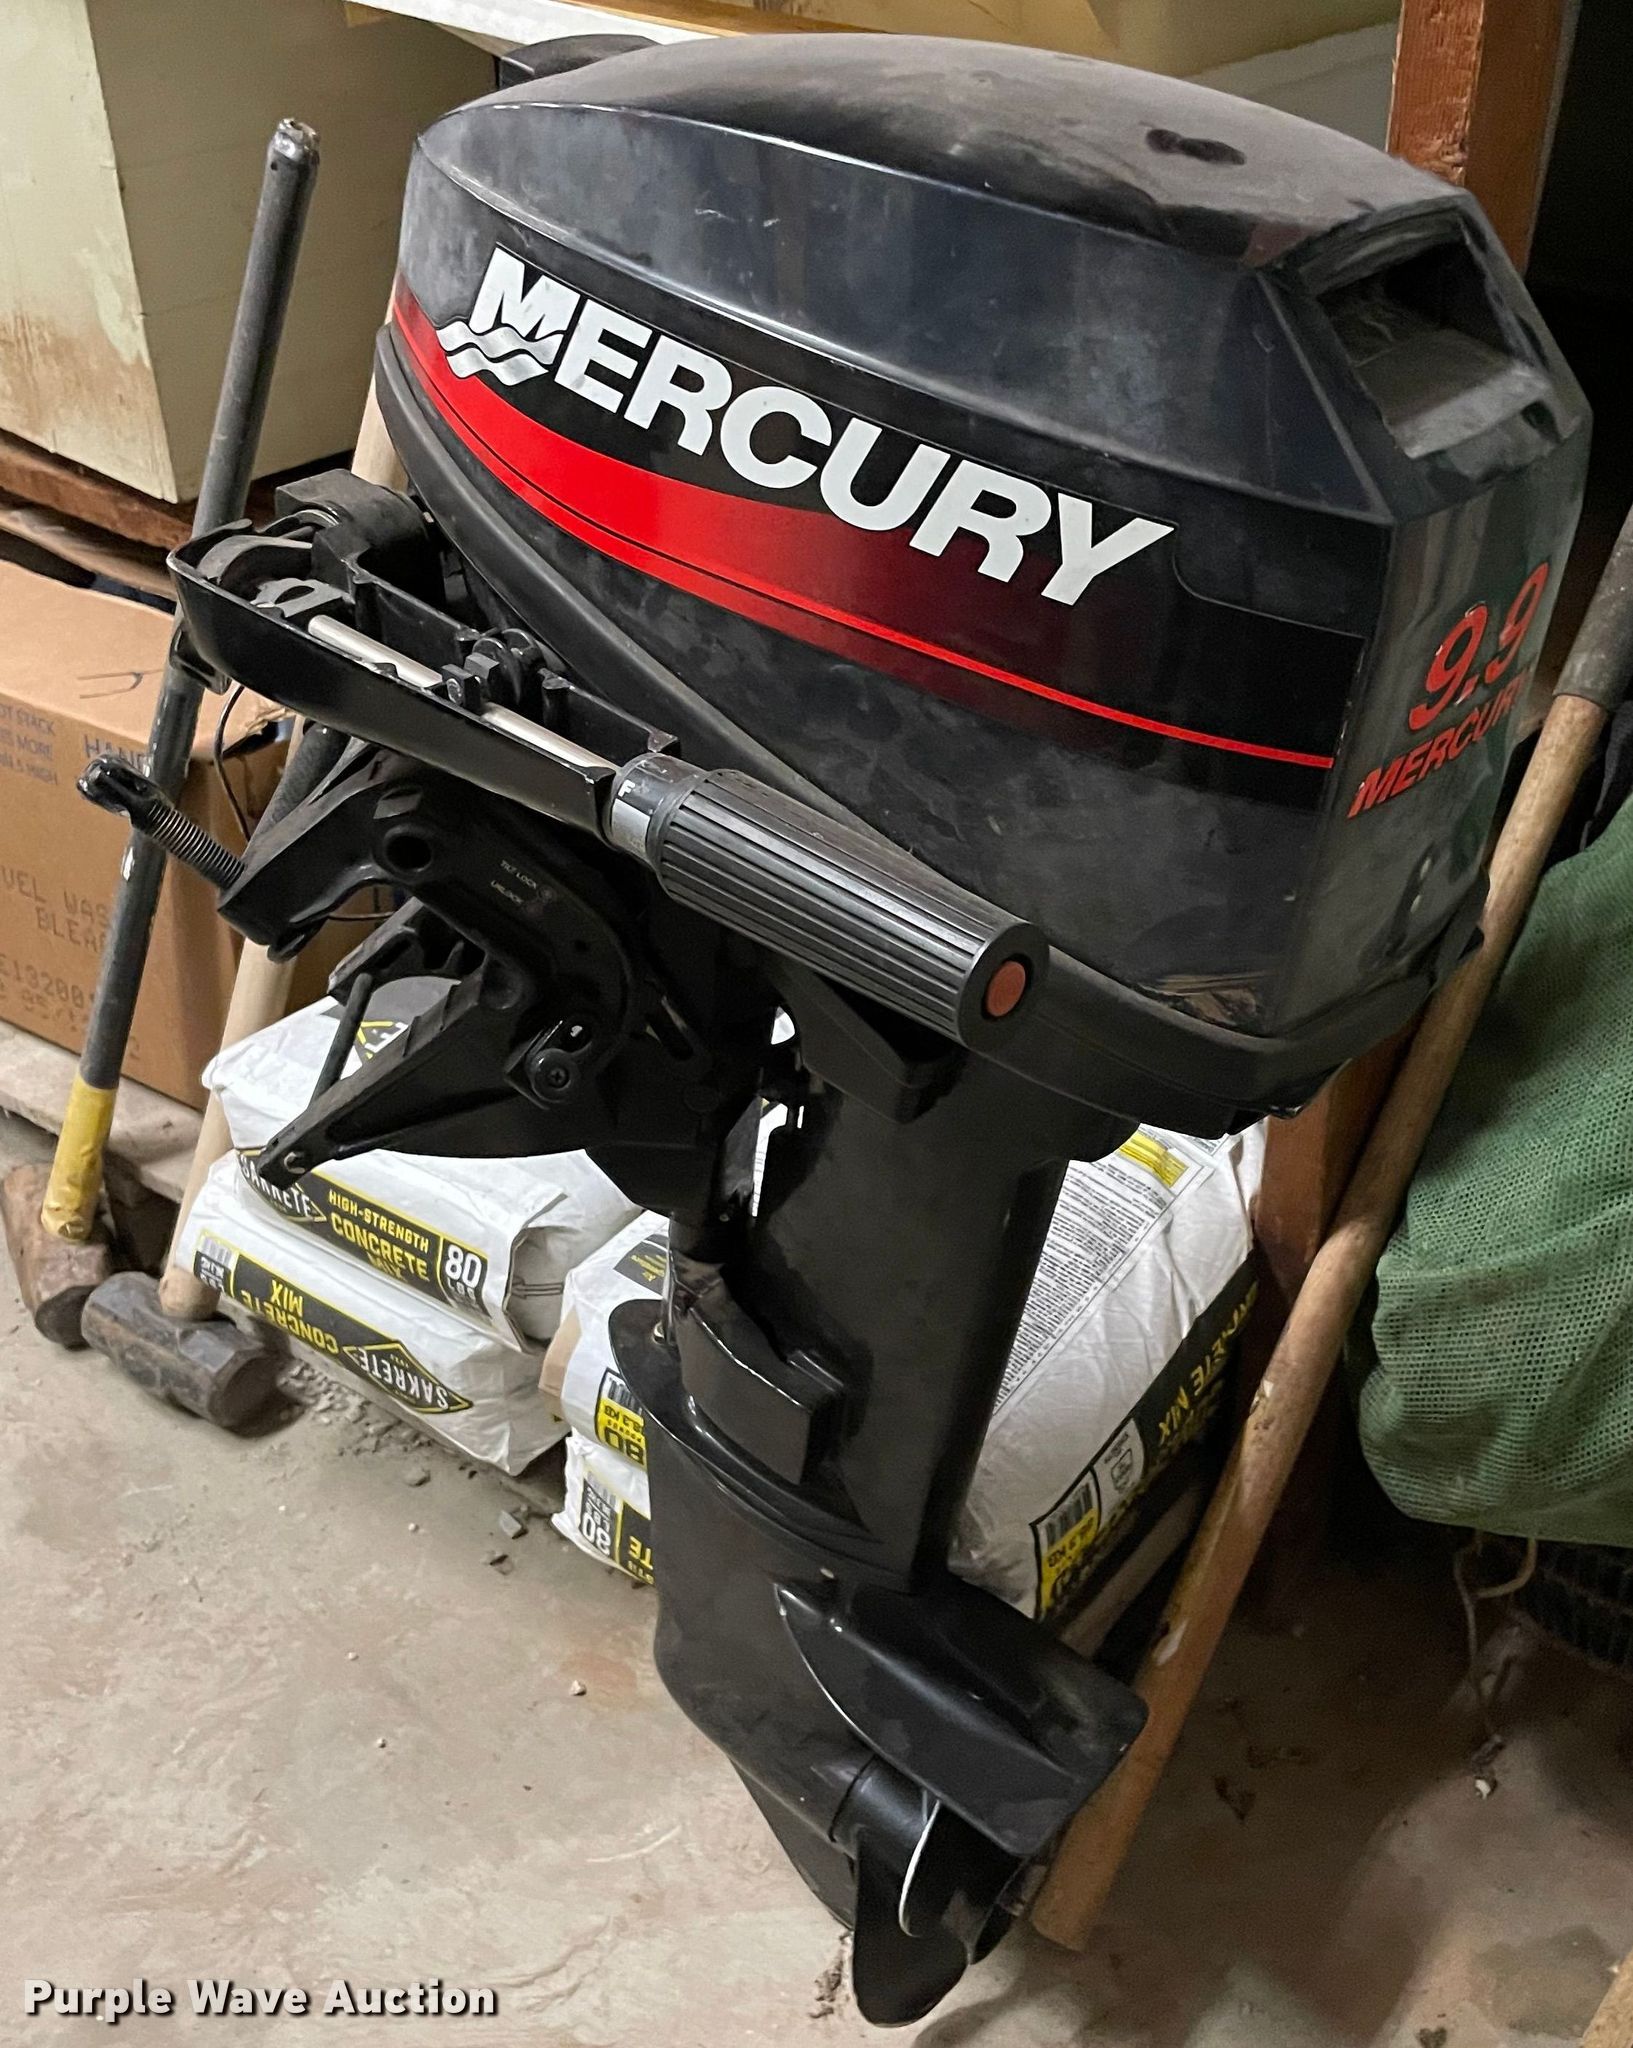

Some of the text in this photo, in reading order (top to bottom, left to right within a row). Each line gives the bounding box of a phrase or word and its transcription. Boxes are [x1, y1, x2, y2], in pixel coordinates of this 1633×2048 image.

[466, 246, 1175, 606] MERCURY
[1408, 562, 1549, 731] 9.9
[617, 779, 637, 798] F
[328, 1188, 430, 1254] HIGH-STRENGTH
[330, 1211, 431, 1283] CONCRETE
[270, 1278, 304, 1318] MIX
[445, 1243, 483, 1289] 80
[240, 1288, 340, 1355] CONCRETE
[358, 1346, 449, 1410] SAKRETE
[604, 1426, 645, 1466] 80
[582, 1511, 612, 1556] 80
